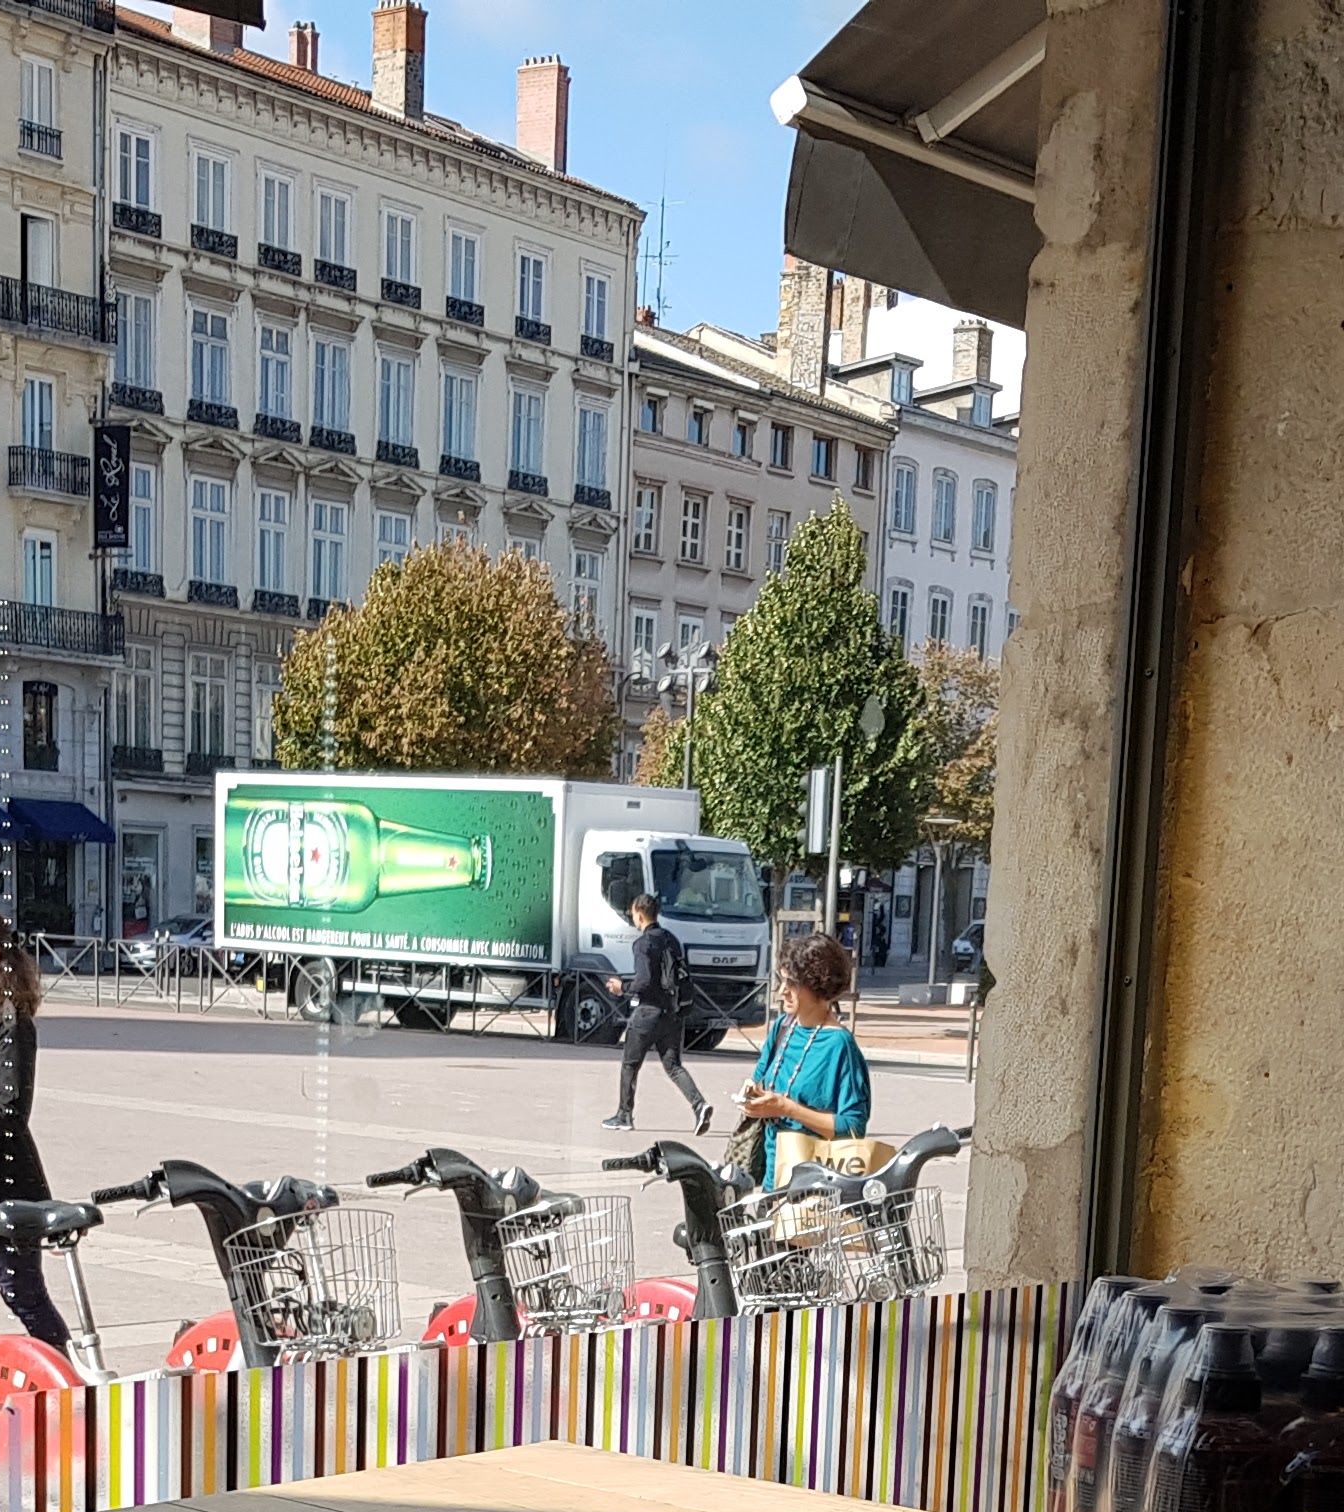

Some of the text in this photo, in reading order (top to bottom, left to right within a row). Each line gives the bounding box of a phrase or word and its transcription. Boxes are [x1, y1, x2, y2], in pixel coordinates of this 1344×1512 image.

[230, 922, 255, 938] L'ABUS
[256, 924, 291, 941] D'ALCOOL
[292, 927, 305, 942] EST
[306, 928, 349, 946] DANGEREUX
[351, 931, 371, 947] POUR
[373, 932, 383, 948] LA
[420, 937, 469, 954] CONSOMMER
[471, 940, 490, 956] AVEC
[712, 956, 738, 964] DAF
[815, 1155, 866, 1176] we
